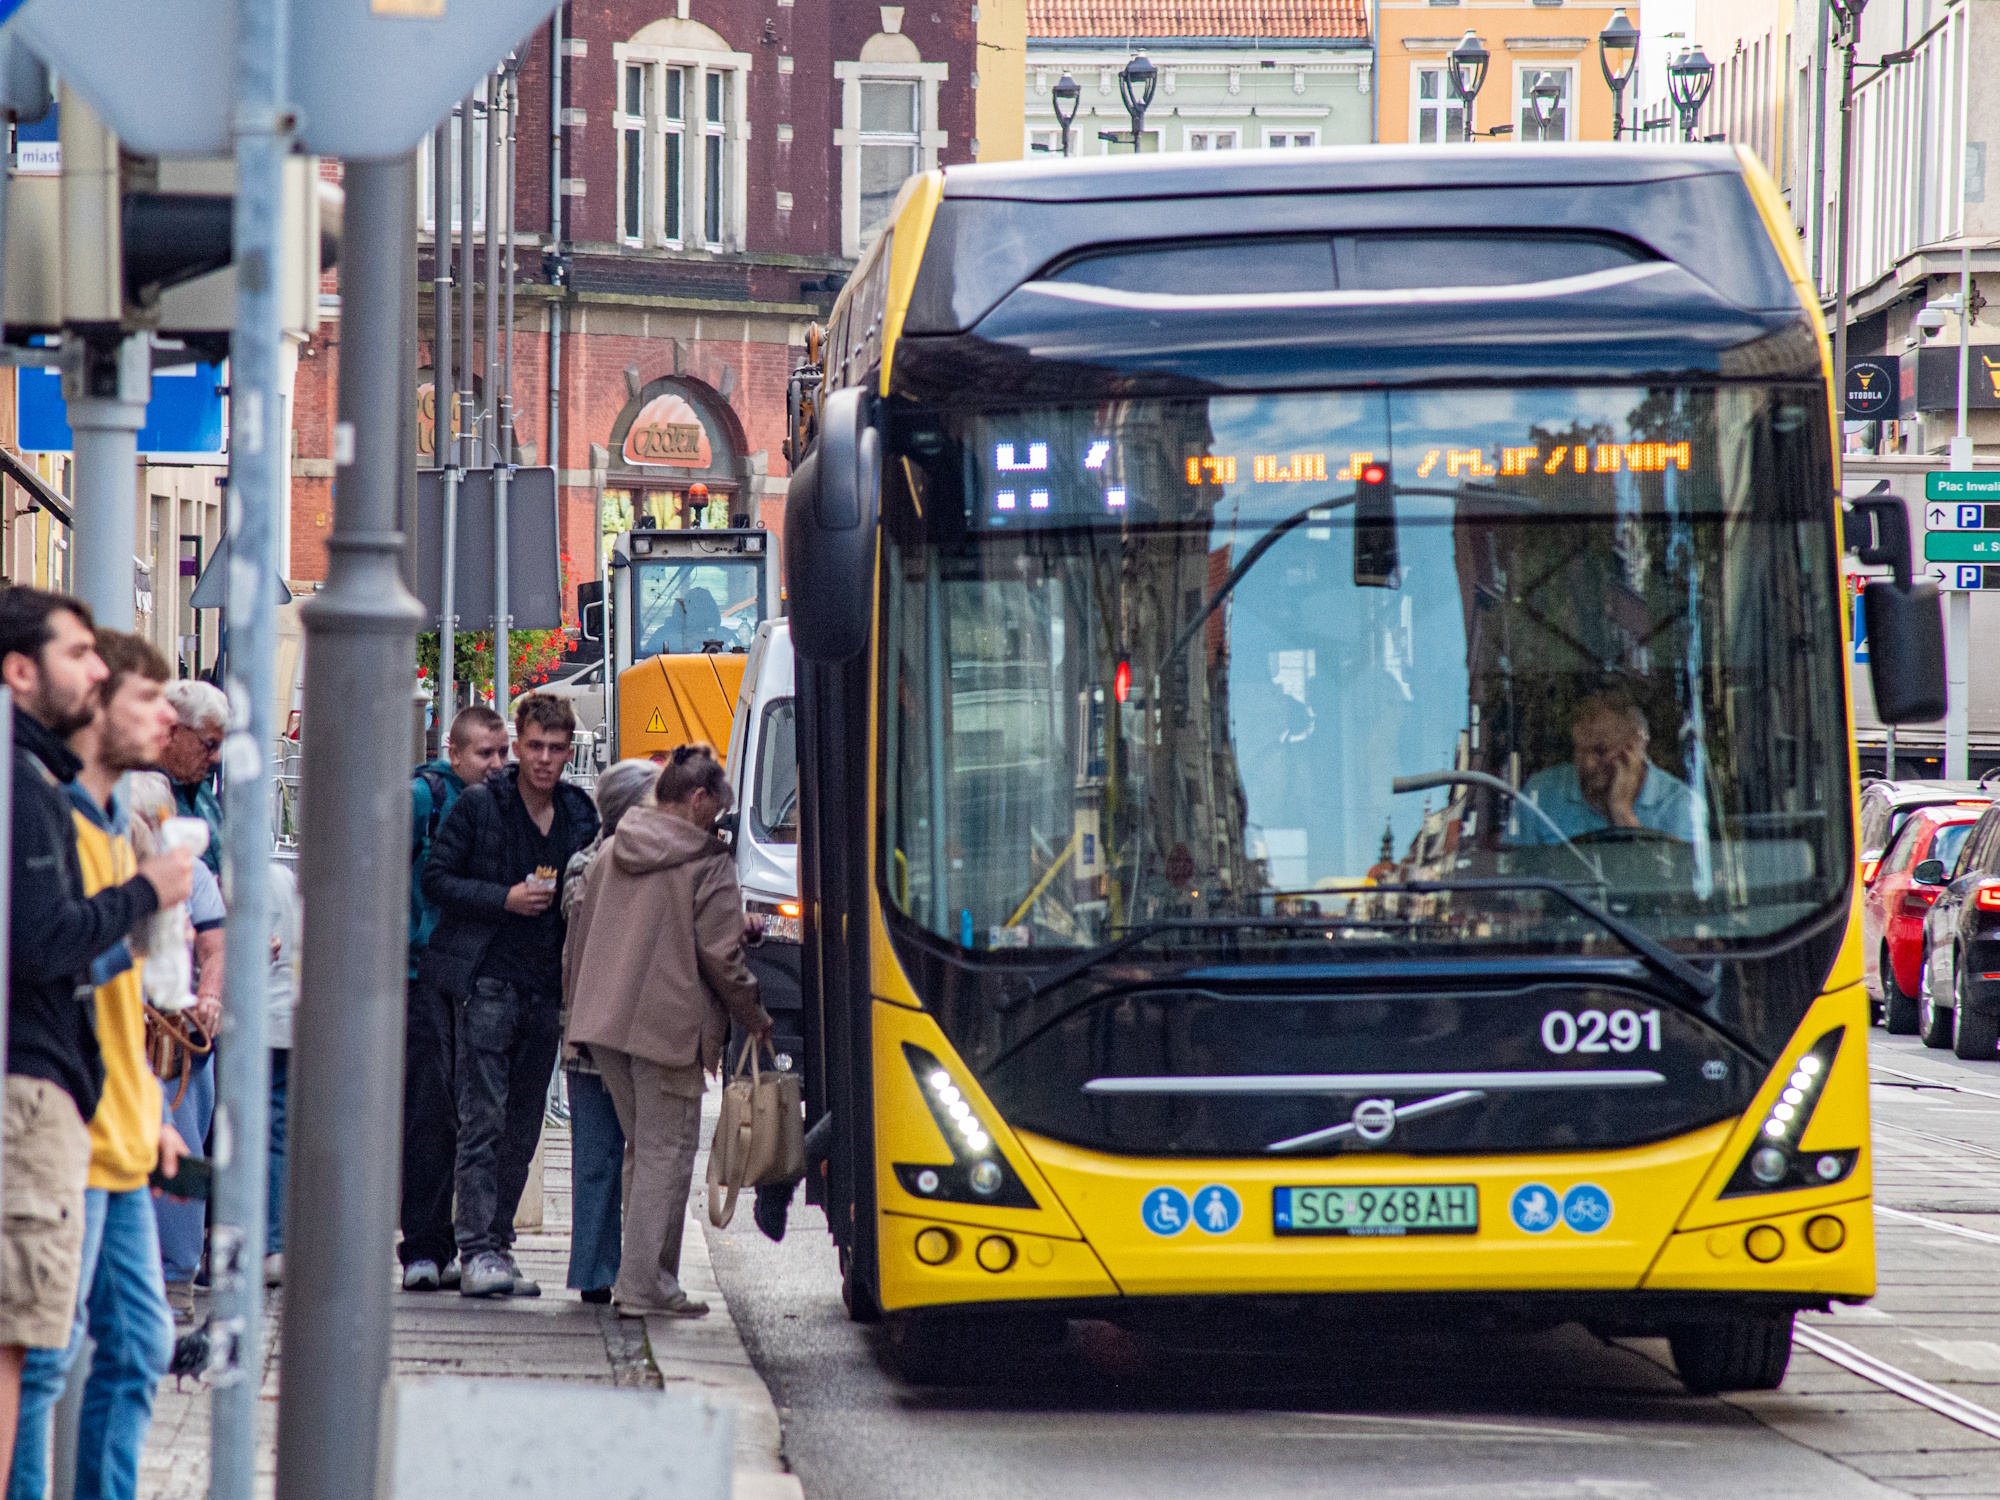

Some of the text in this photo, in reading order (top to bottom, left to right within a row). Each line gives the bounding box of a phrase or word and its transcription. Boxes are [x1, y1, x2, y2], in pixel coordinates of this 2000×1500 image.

[1848, 391, 1882, 400] STODOLA
[1937, 481, 1964, 492] Plac
[1961, 506, 1978, 527] P
[1972, 541, 2000, 552] ul. S
[1960, 567, 1977, 588] P
[1541, 1009, 1661, 1054] 0291
[1300, 1190, 1467, 1224] SG 968AH
